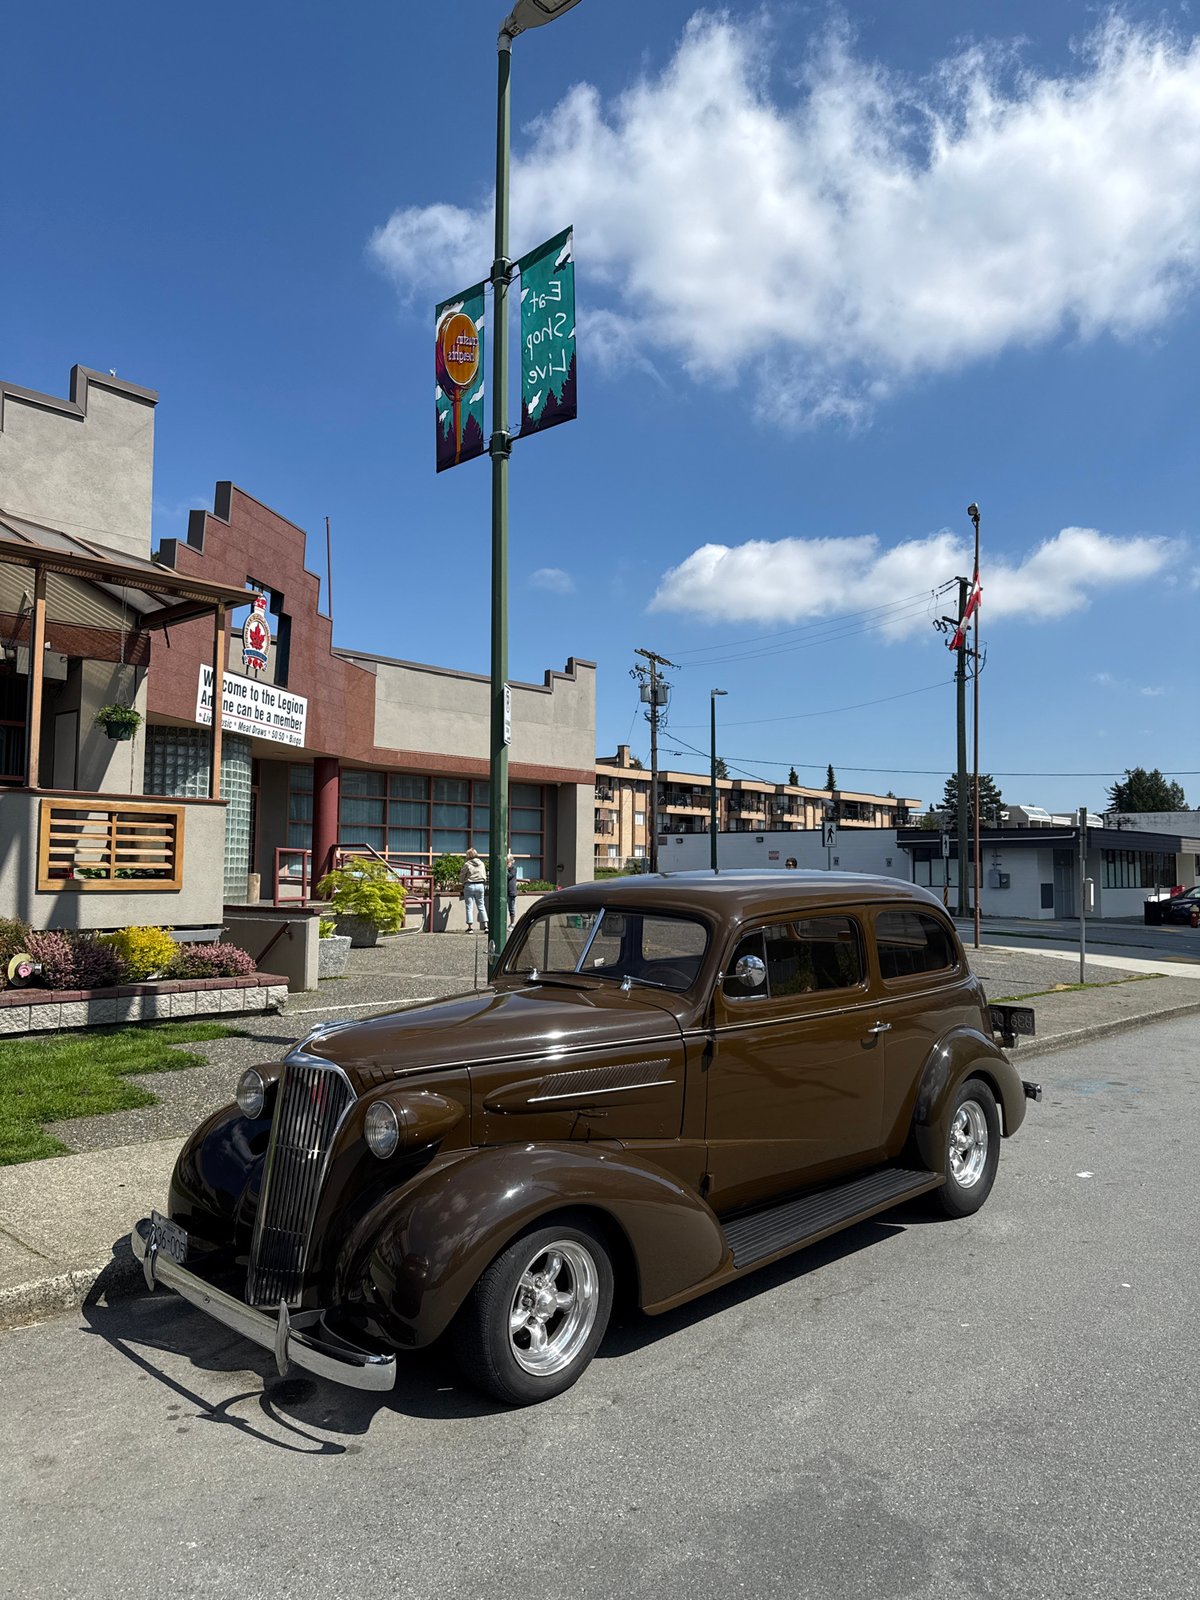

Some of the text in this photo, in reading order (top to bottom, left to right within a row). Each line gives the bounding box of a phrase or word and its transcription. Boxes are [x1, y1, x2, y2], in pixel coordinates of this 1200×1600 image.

[200, 689, 302, 730] Anne can be a member
[203, 669, 304, 715] Wcome to the Legion
[238, 721, 251, 733] Meat
[252, 725, 267, 737] Draws
[289, 734, 302, 747] Bingo
[154, 1225, 187, 1263] 36-005
